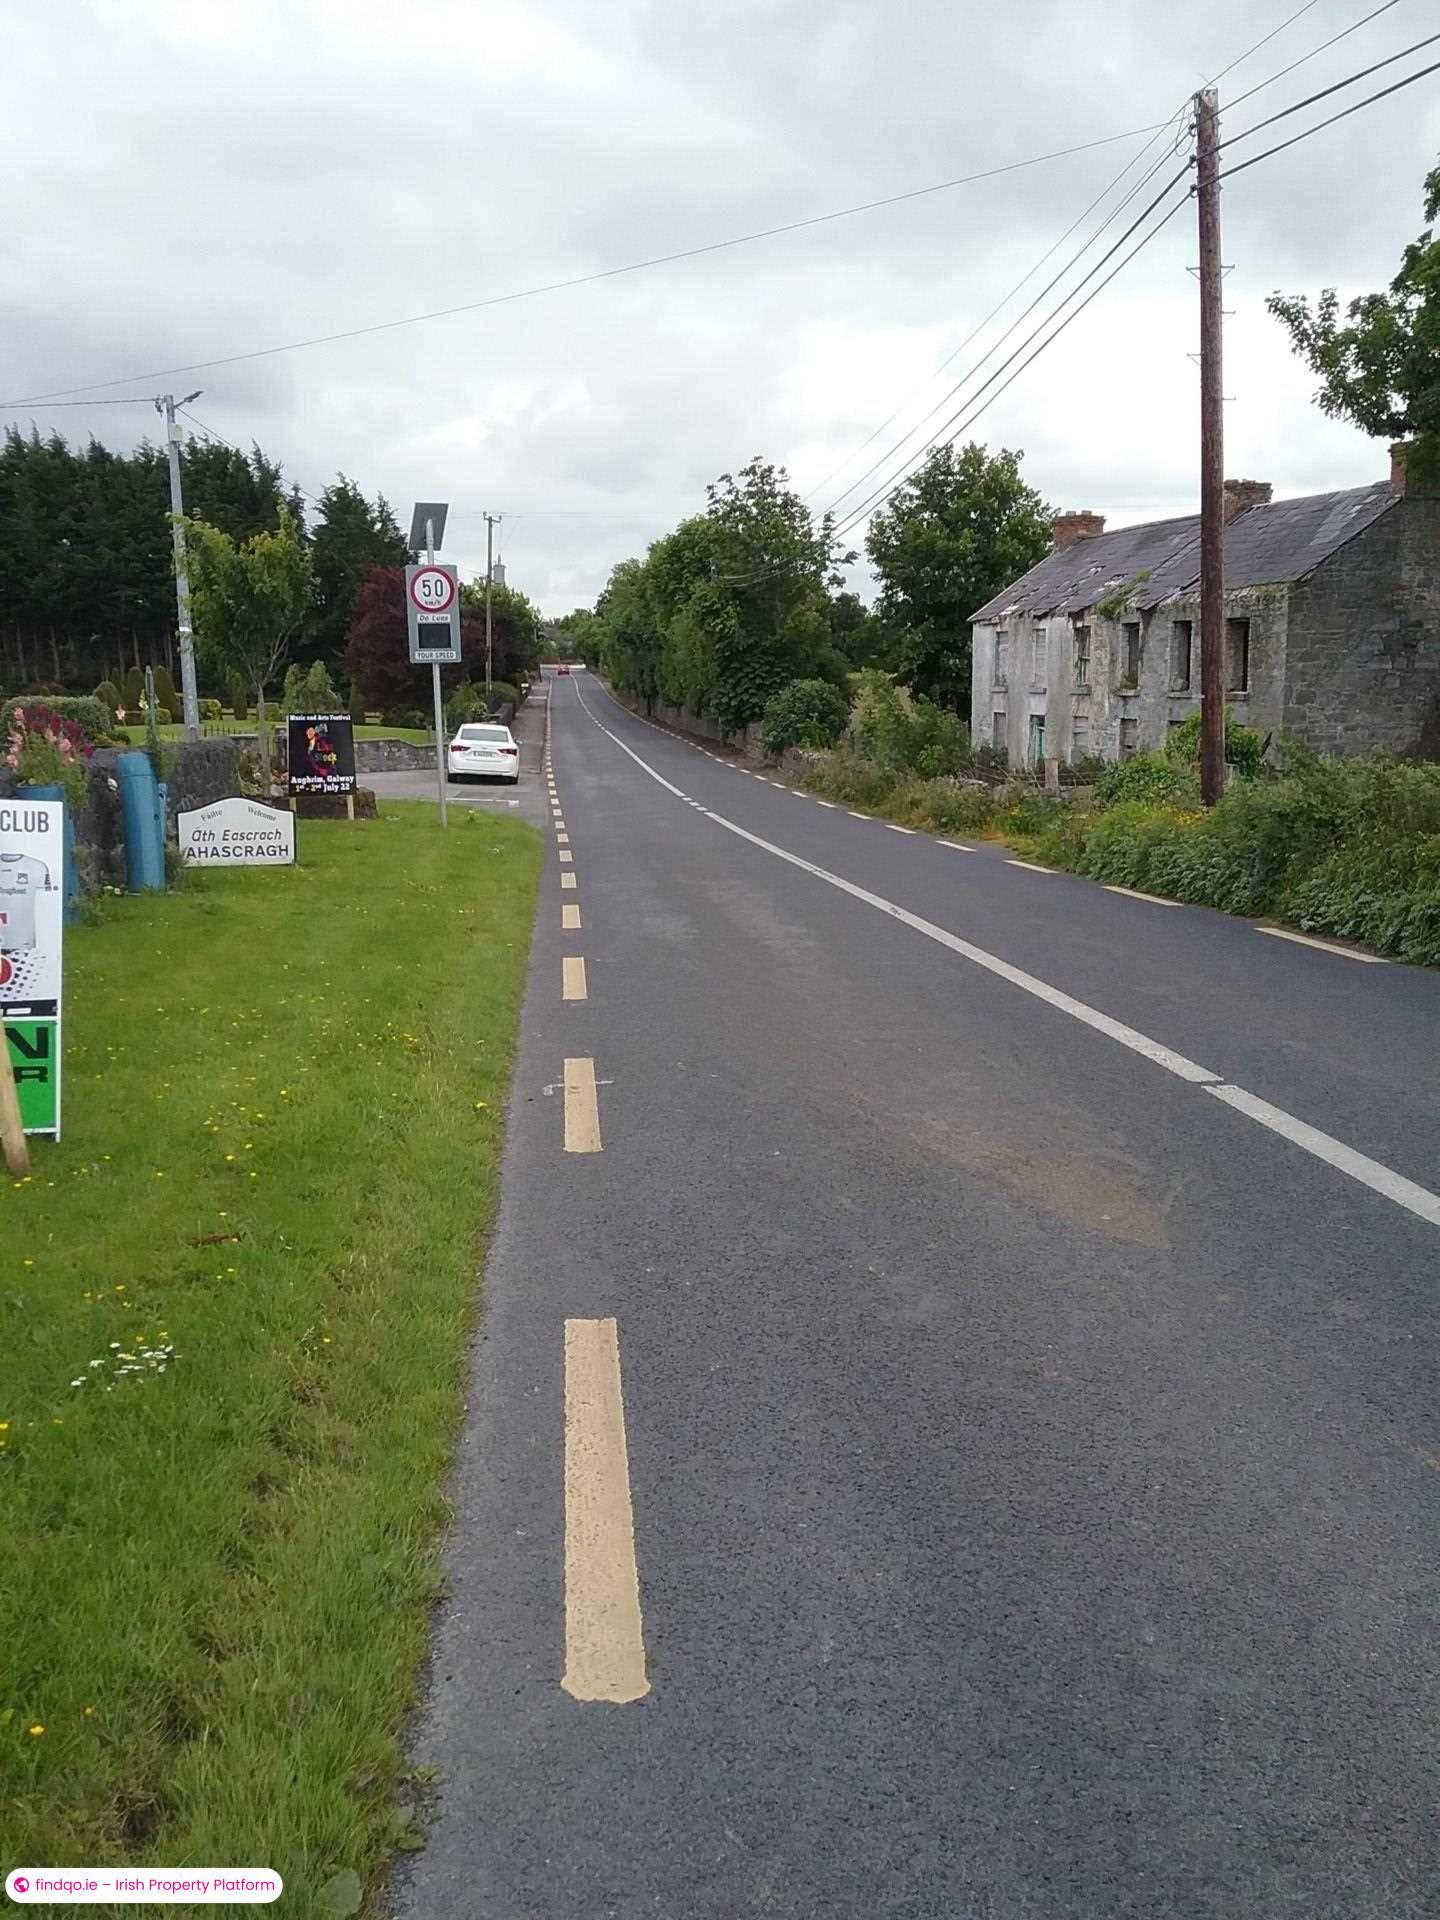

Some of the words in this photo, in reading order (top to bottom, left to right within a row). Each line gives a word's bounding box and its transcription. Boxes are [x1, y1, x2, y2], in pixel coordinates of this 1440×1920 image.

[422, 579, 444, 597] 50
[435, 651, 454, 659] SPEED
[327, 774, 354, 783] Galway
[311, 784, 322, 792] 2nd
[323, 783, 339, 793] July
[340, 783, 350, 791] 22
[248, 806, 277, 821] Welcome
[0, 810, 50, 832] CLUB
[222, 829, 282, 841] Eascrach
[186, 844, 289, 859] AHASCRAGH
